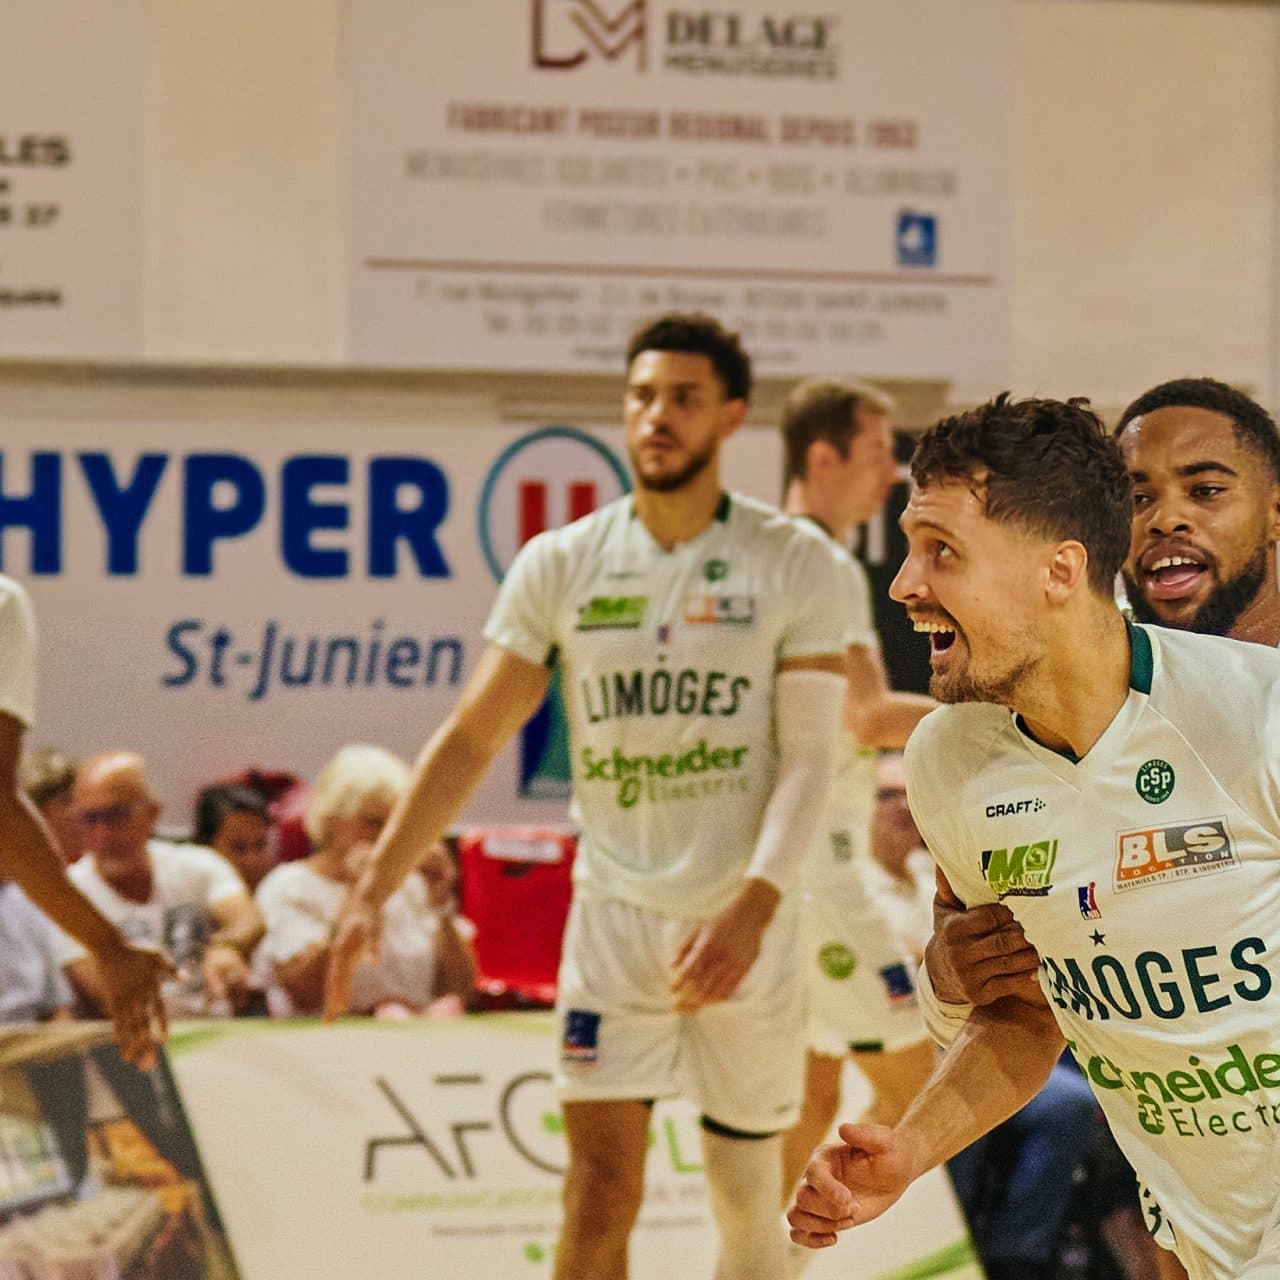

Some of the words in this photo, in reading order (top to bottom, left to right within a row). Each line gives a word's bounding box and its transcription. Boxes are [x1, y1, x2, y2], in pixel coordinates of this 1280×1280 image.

[666, 9, 840, 50] DELAGE
[0, 451, 452, 578] HYPER
[161, 618, 466, 701] St-Junien
[582, 668, 751, 723] LIMOGES
[582, 738, 749, 782] Schneider
[1140, 767, 1171, 792] CSP
[985, 800, 1033, 818] CRAFT
[1119, 851, 1230, 879] LOCATION
[1121, 826, 1225, 868] BLS
[1042, 937, 1272, 1020] MOGES
